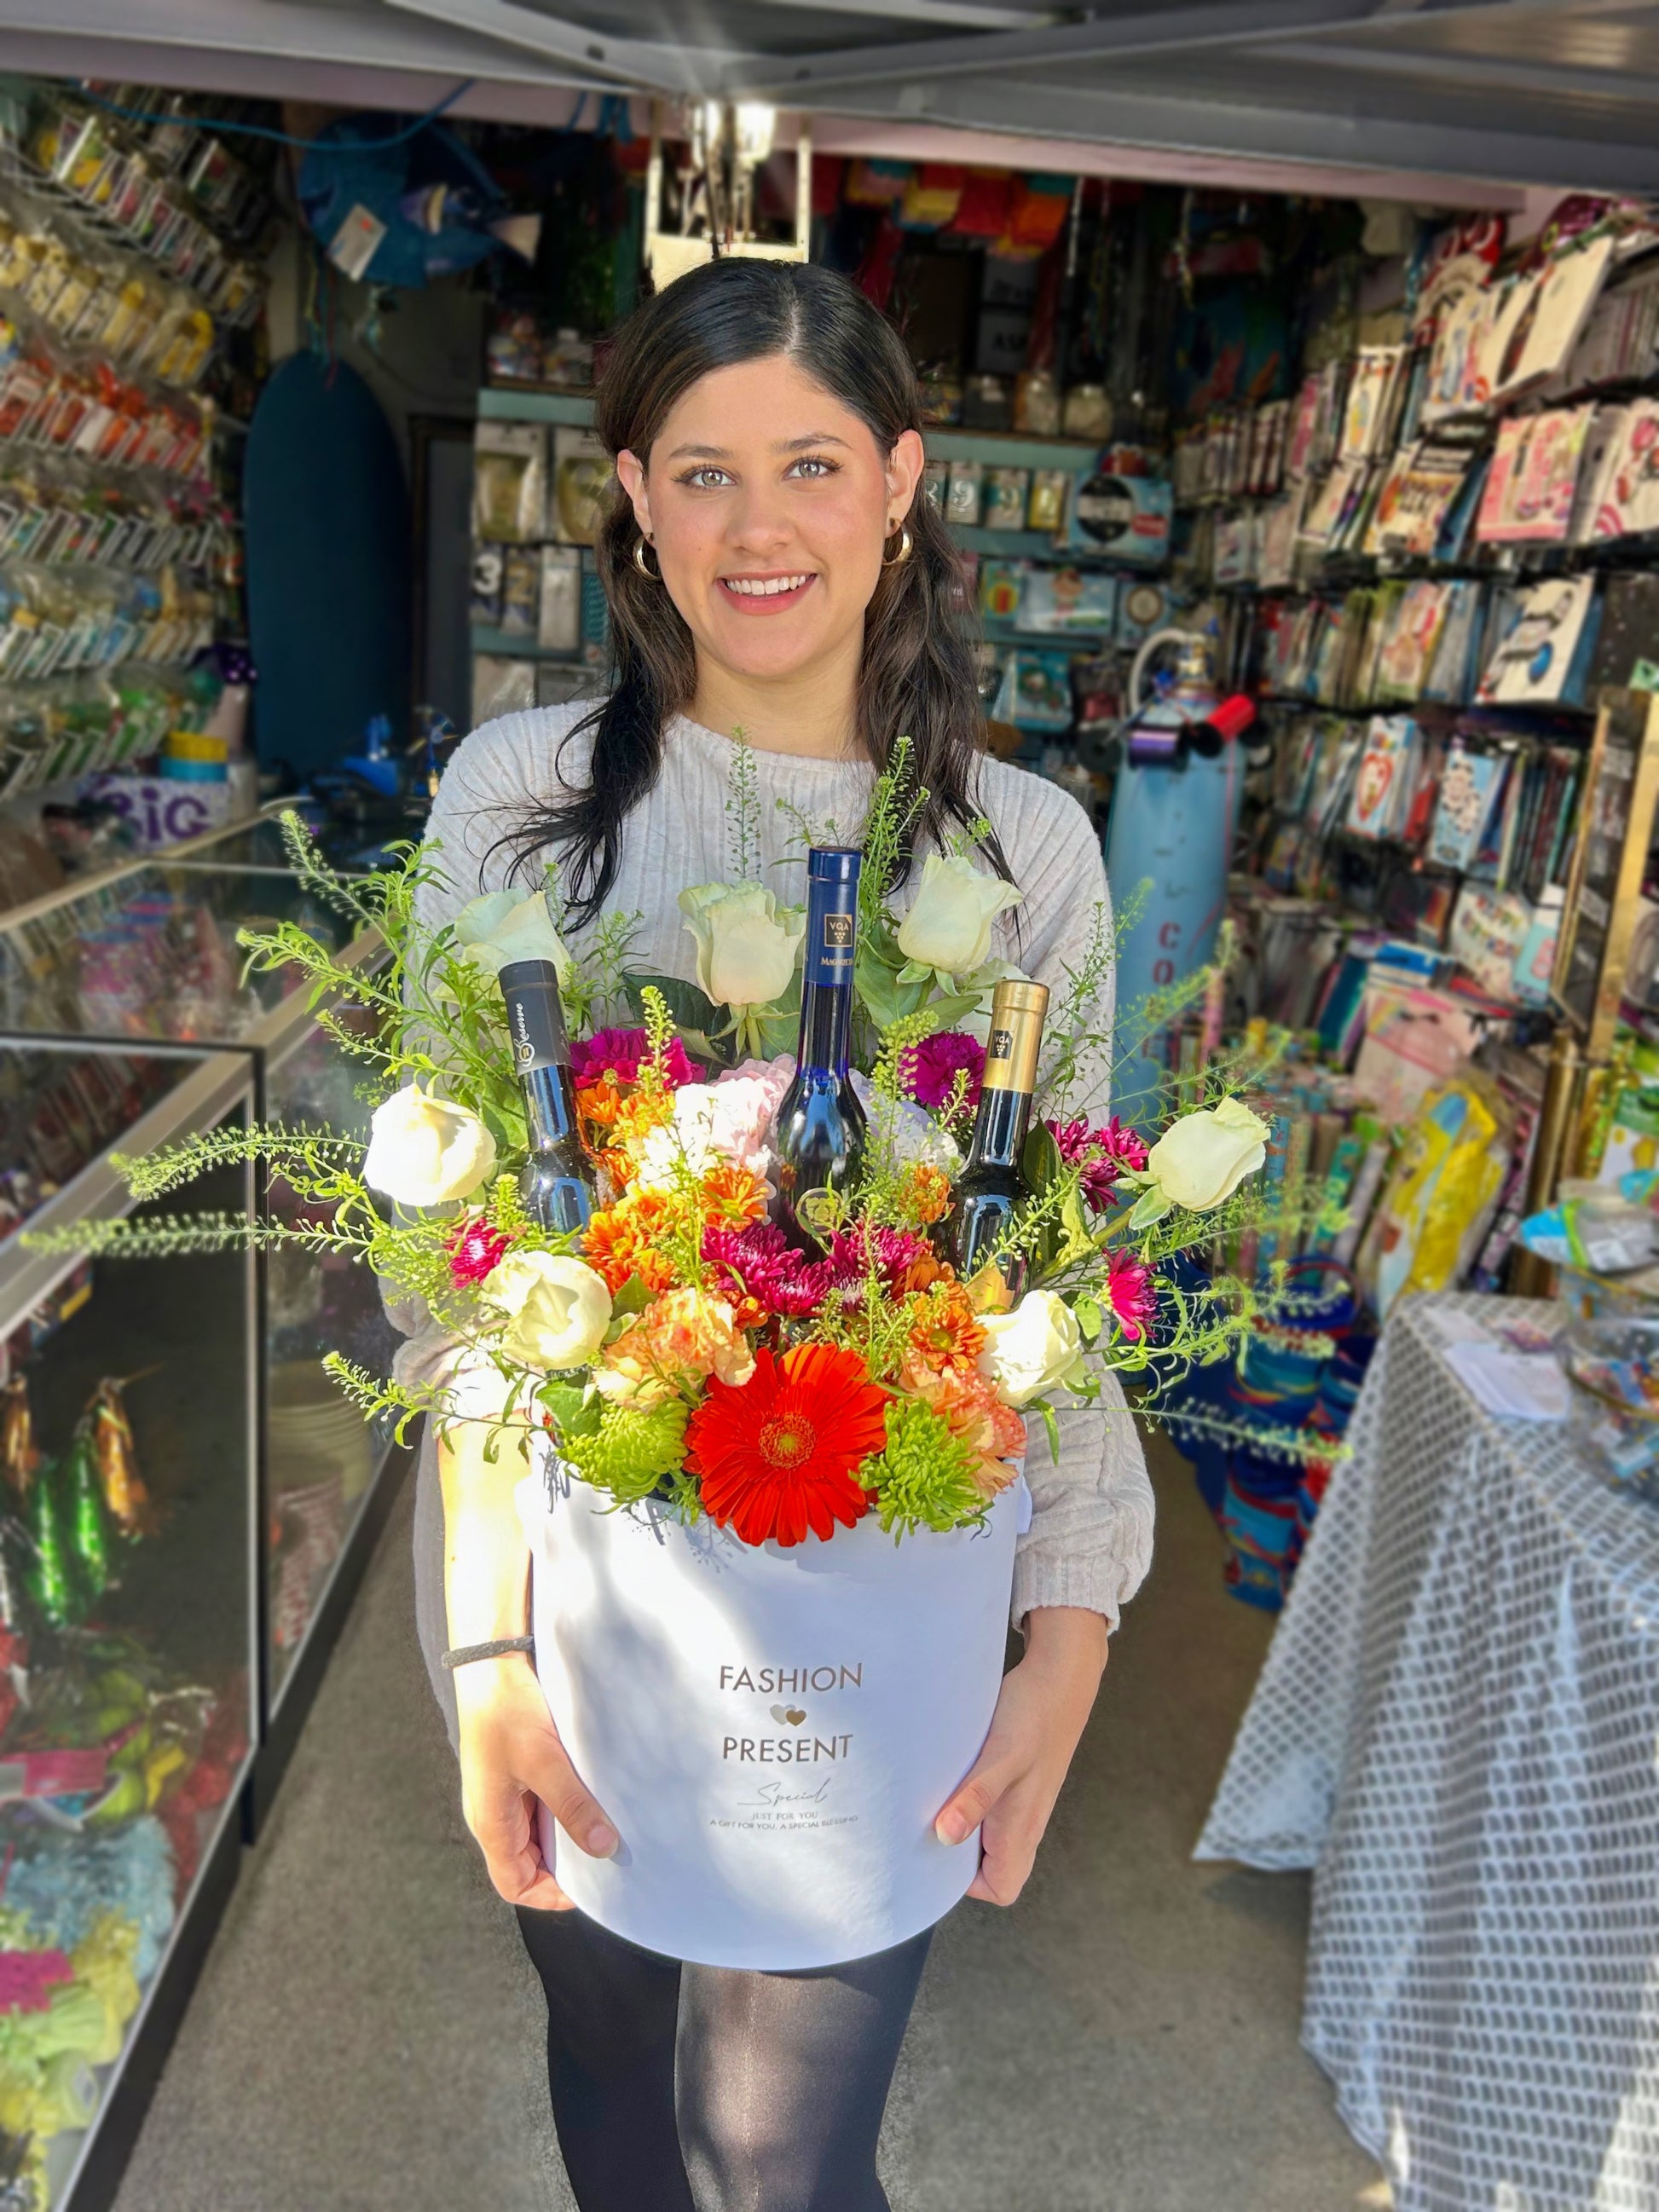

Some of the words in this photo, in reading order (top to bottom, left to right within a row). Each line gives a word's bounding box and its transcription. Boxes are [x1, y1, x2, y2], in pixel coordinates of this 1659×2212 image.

[473, 553, 503, 594] 3
[830, 921, 849, 931] VQA
[994, 1035, 1009, 1043] VQA
[720, 1662, 863, 1693] FASHION
[723, 1734, 853, 1763] PRESENT
[737, 1777, 831, 1806] Special
[751, 1812, 772, 1821] JUST
[789, 1821, 819, 1829] SPECIAL
[821, 1815, 858, 1827] BLESSING
